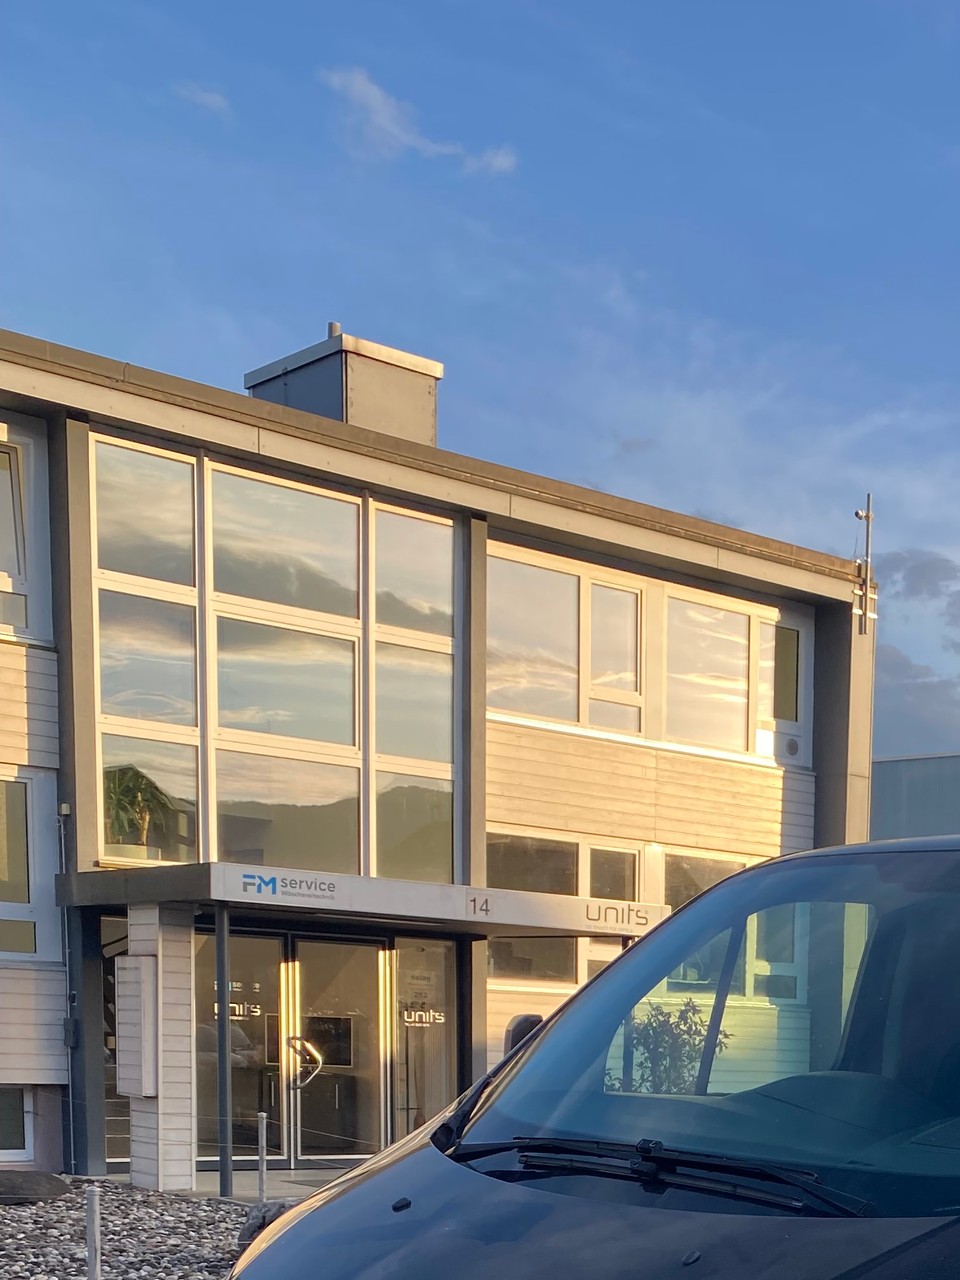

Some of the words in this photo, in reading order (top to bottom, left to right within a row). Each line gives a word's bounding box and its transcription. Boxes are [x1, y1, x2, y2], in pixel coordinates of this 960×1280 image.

[242, 873, 277, 895] FM
[280, 877, 336, 893] service
[470, 896, 491, 916] 14
[586, 903, 649, 926] units
[213, 1001, 261, 1017] nits
[404, 1009, 445, 1023] units
